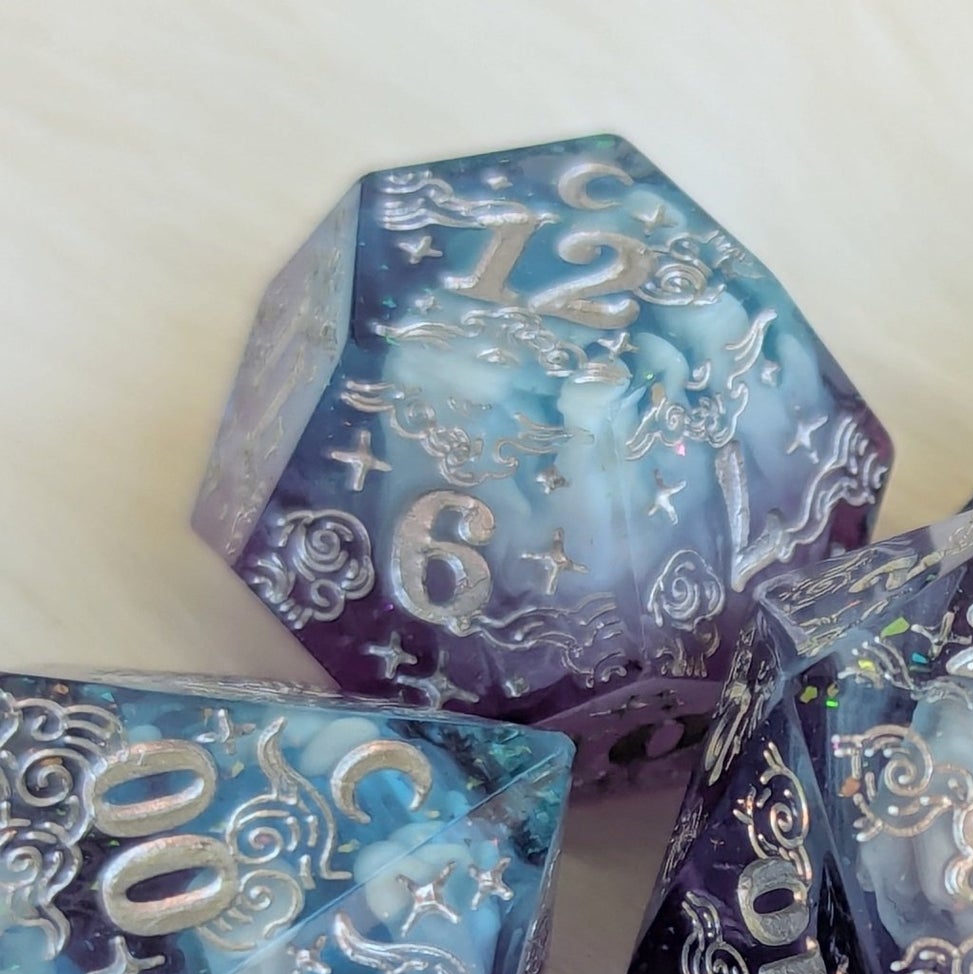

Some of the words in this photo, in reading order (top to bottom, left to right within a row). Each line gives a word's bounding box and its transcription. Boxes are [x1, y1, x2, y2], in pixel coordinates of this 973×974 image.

[444, 209, 654, 330] 12
[393, 489, 495, 624] 6
[88, 738, 240, 936] 00
